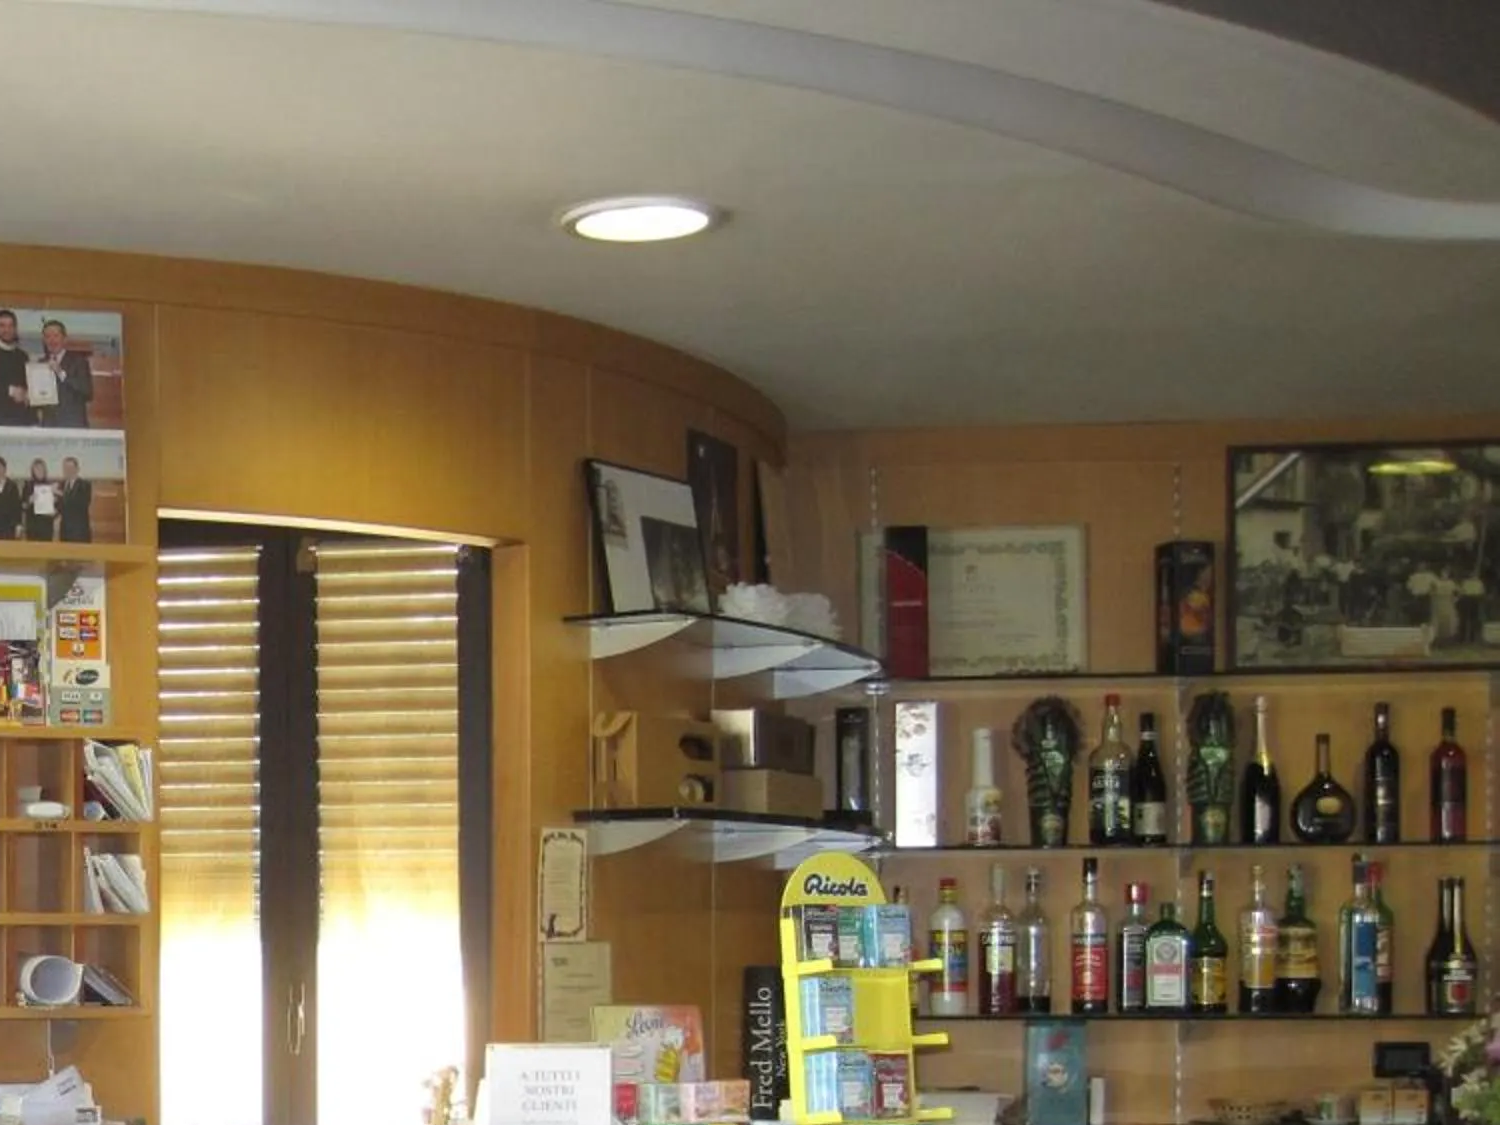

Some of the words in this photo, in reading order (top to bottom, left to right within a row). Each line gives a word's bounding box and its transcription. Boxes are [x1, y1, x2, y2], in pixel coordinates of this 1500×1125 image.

[803, 873, 869, 897] Ricola
[748, 986, 773, 1052] Mello
[750, 1060, 774, 1110] Fred
[520, 1100, 578, 1112] CLIENTI
